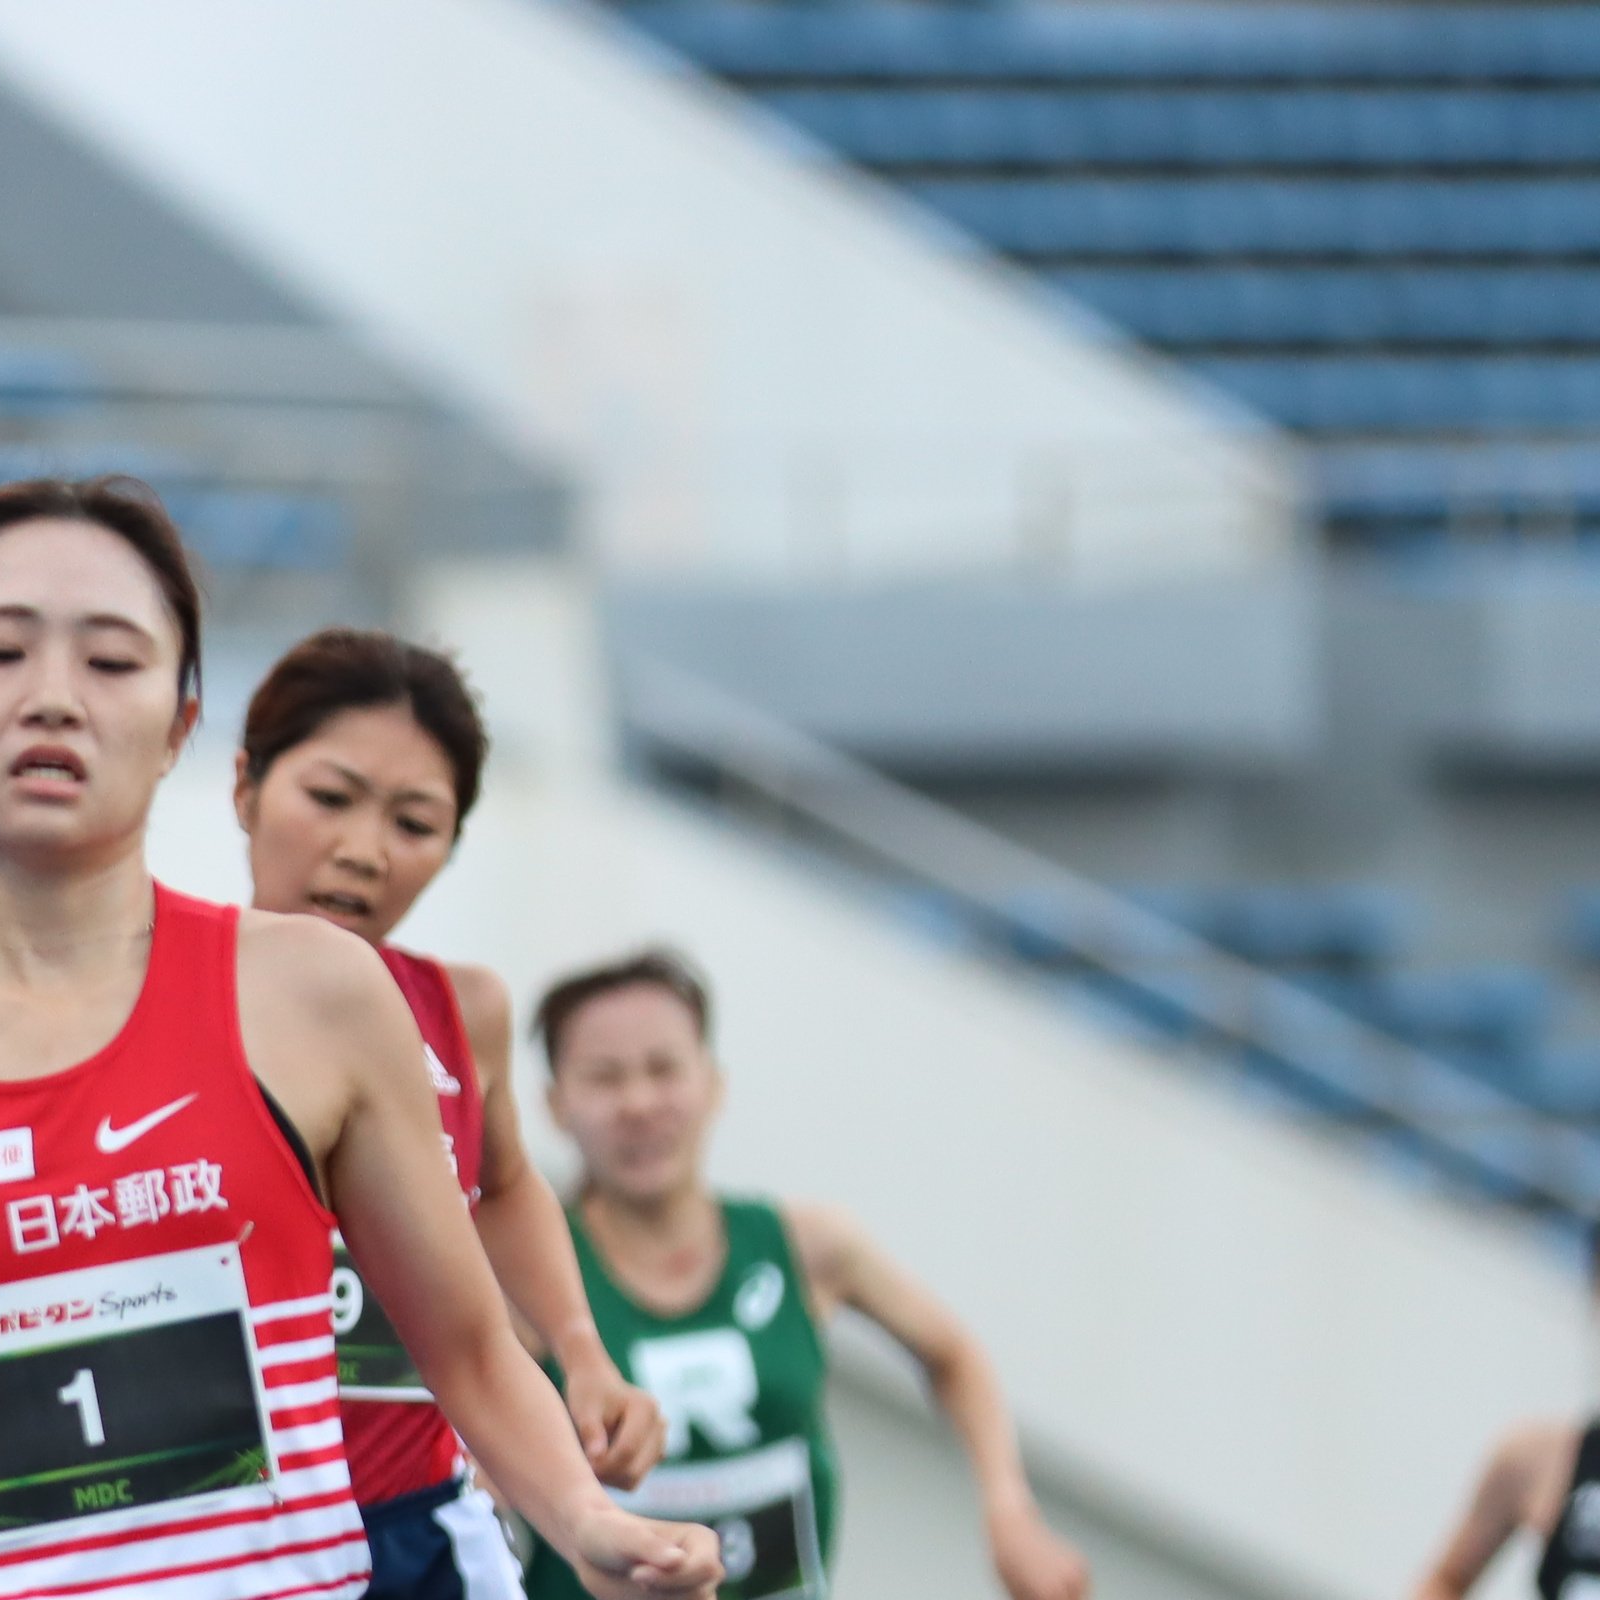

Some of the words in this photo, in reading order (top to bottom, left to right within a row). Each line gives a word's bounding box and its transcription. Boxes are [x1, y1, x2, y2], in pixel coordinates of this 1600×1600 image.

[5, 1159, 229, 1255] 日本郵政
[99, 1281, 179, 1320] Sports
[58, 1369, 105, 1446] 1
[630, 1328, 760, 1456] R
[72, 1479, 134, 1511] MDC
